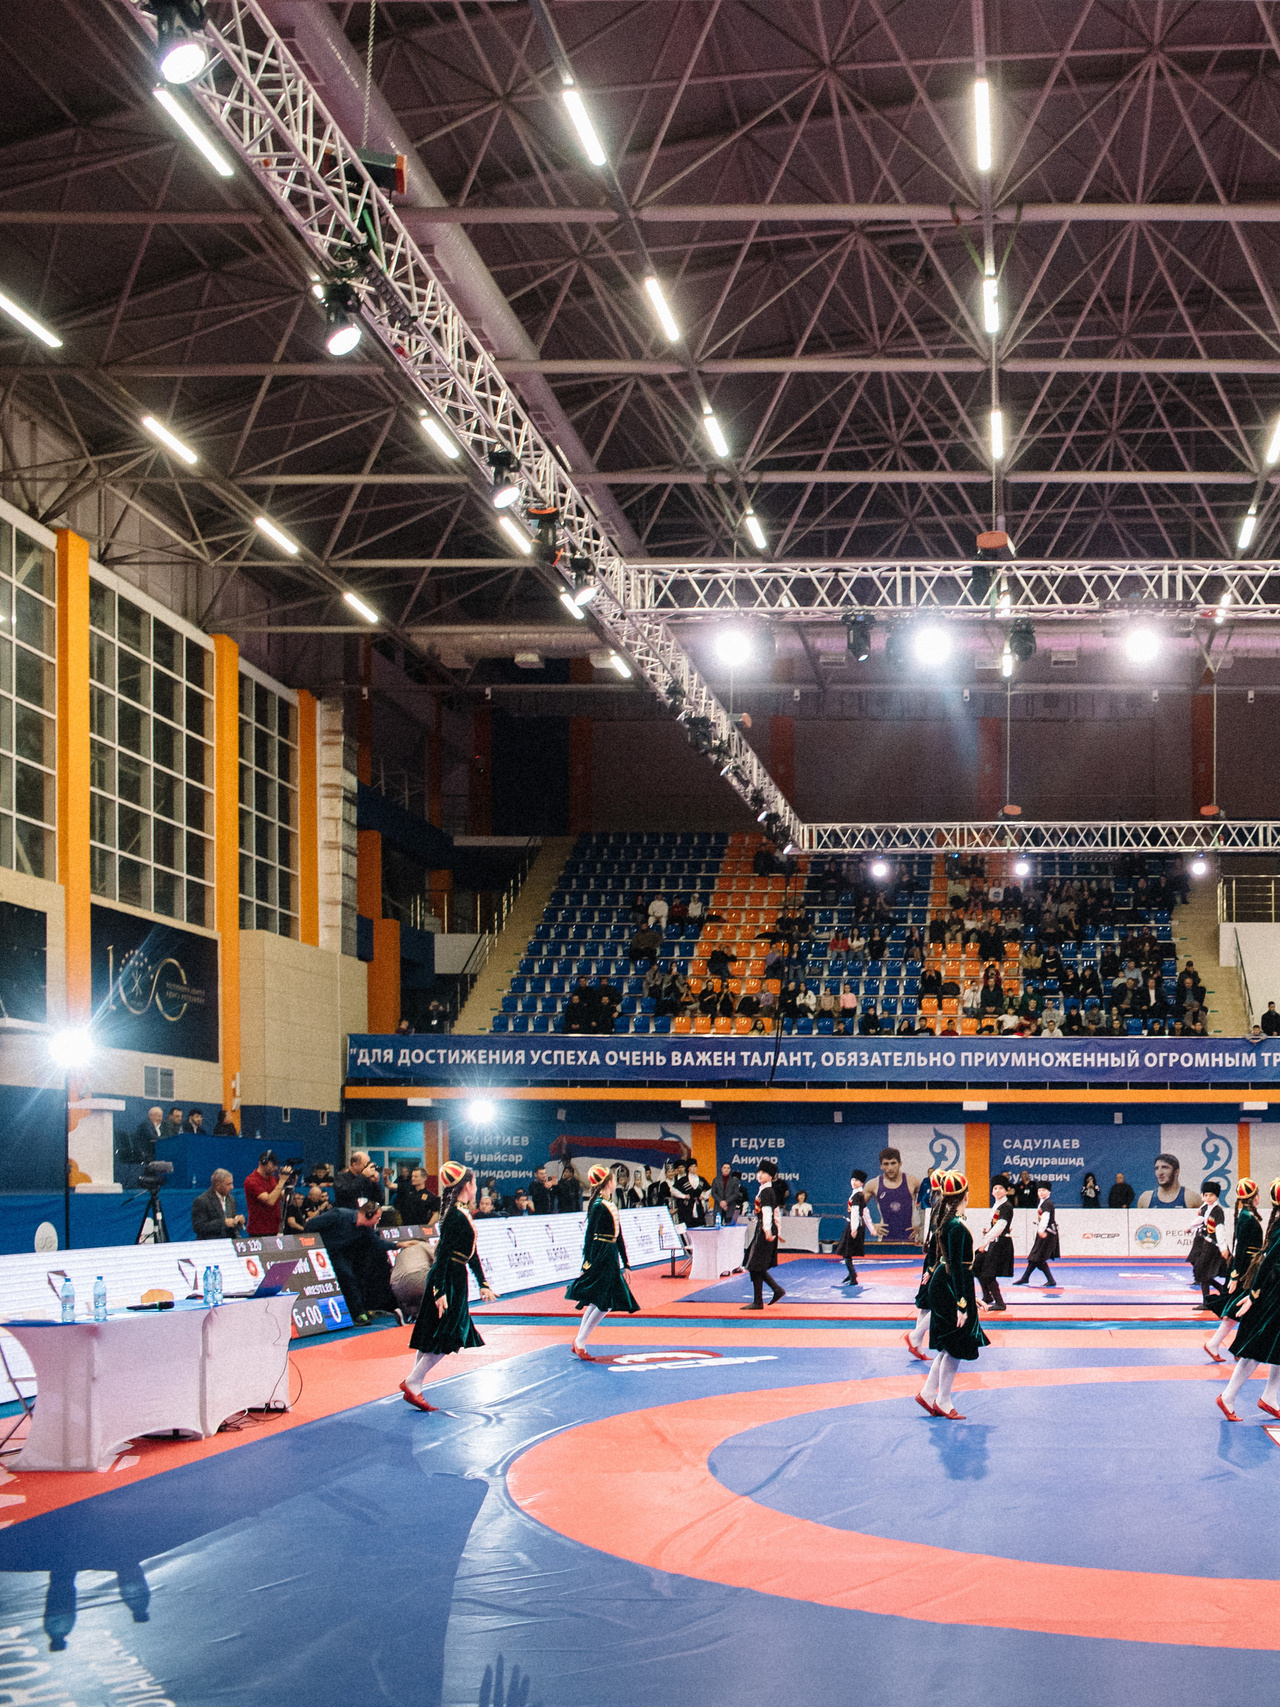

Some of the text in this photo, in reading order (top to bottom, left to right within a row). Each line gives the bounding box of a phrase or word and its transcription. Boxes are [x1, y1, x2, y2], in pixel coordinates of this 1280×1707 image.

[350, 1049, 393, 1066] "ДЛЯ
[397, 1049, 525, 1067] ДОСТИЖЕНИЯ
[530, 1049, 600, 1065] УСПЕХА
[605, 1050, 667, 1066] ОЧЕНЬ
[671, 1051, 736, 1067] ВАЖЕН
[740, 1051, 817, 1069] ТАЛАНТ,
[821, 1051, 956, 1068] ОБЯЗАТЕЛЬНО
[960, 1049, 1140, 1068] ПРИУМНОЖЕННЫЙ
[1144, 1052, 1257, 1068] ОГРОМНЫМ
[731, 1137, 786, 1150] ГЕДУЕВ
[1002, 1138, 1081, 1151] САДУЛАЕВ
[464, 1151, 524, 1165] Бувайсар
[1003, 1154, 1085, 1169] Абдулрашид
[466, 1167, 533, 1180] амидович
[333, 1280, 341, 1292] 2
[327, 1298, 342, 1323] 0
